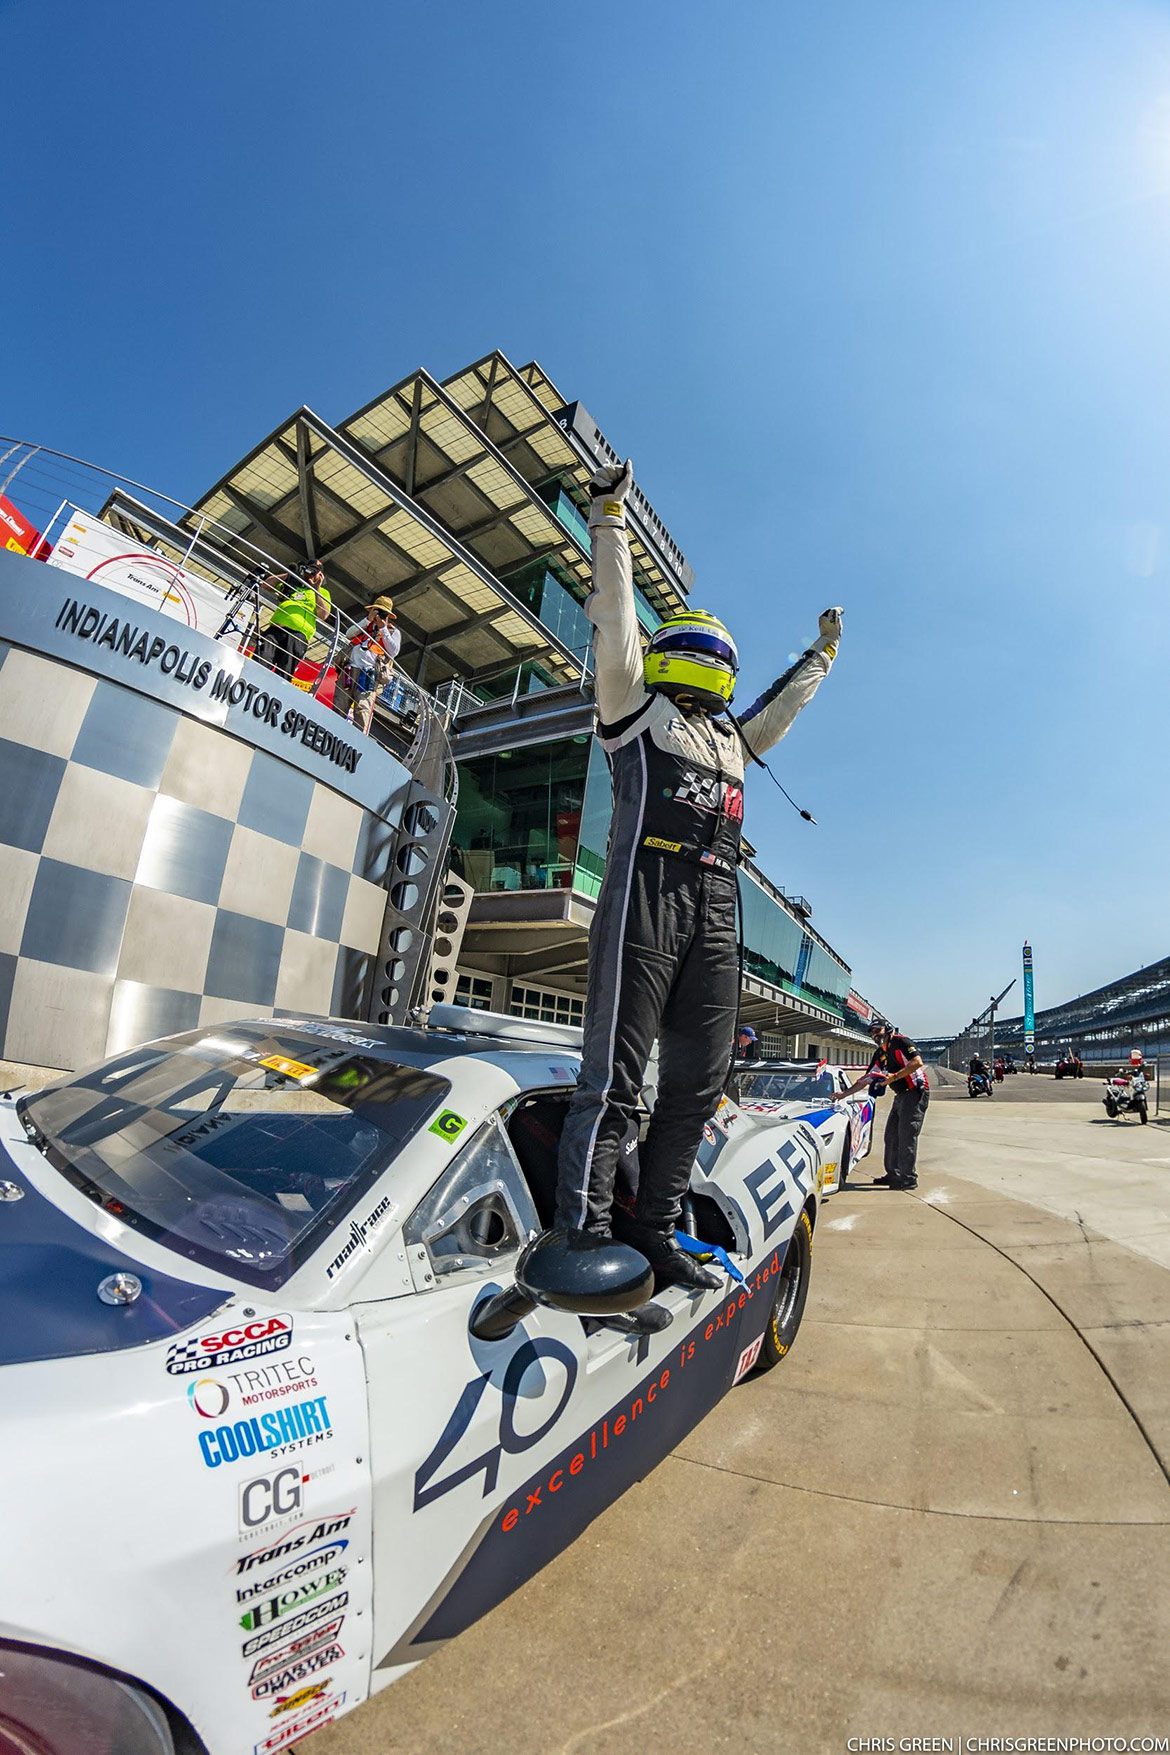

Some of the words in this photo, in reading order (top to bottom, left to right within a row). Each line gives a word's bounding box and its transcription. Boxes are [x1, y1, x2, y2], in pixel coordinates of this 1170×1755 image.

[594, 445, 600, 455] 1
[633, 502, 640, 513] 5
[643, 515, 649, 526] 6
[652, 527, 657, 537] 7
[660, 540, 666, 551] 8
[668, 552, 673, 563] 9
[674, 559, 683, 576] 10
[55, 598, 212, 689] INDIANAPOLIS
[210, 669, 282, 728] MOTOR
[281, 709, 363, 773] SPEEDWAY
[438, 1113, 463, 1135] G
[169, 1357, 212, 1375] PRO
[216, 1333, 291, 1365] RACING
[201, 1318, 289, 1352] SCCA
[228, 1356, 315, 1393] TRITEC
[242, 1378, 318, 1406] MOTORSPORTS
[198, 1396, 332, 1468] COOLSHIRT
[270, 1430, 333, 1459] SYSTEMS
[413, 1337, 578, 1513] 40
[502, 1370, 670, 1533] excellence
[680, 1341, 696, 1368] is
[242, 1467, 301, 1527] CG
[237, 1536, 306, 1576] Trans
[306, 1516, 351, 1546] Am
[236, 1550, 337, 1603] Intercomp
[244, 1594, 348, 1657] SPEEDCOM
[255, 1646, 336, 1697] QUARTER
[271, 1652, 340, 1694] MASTER
